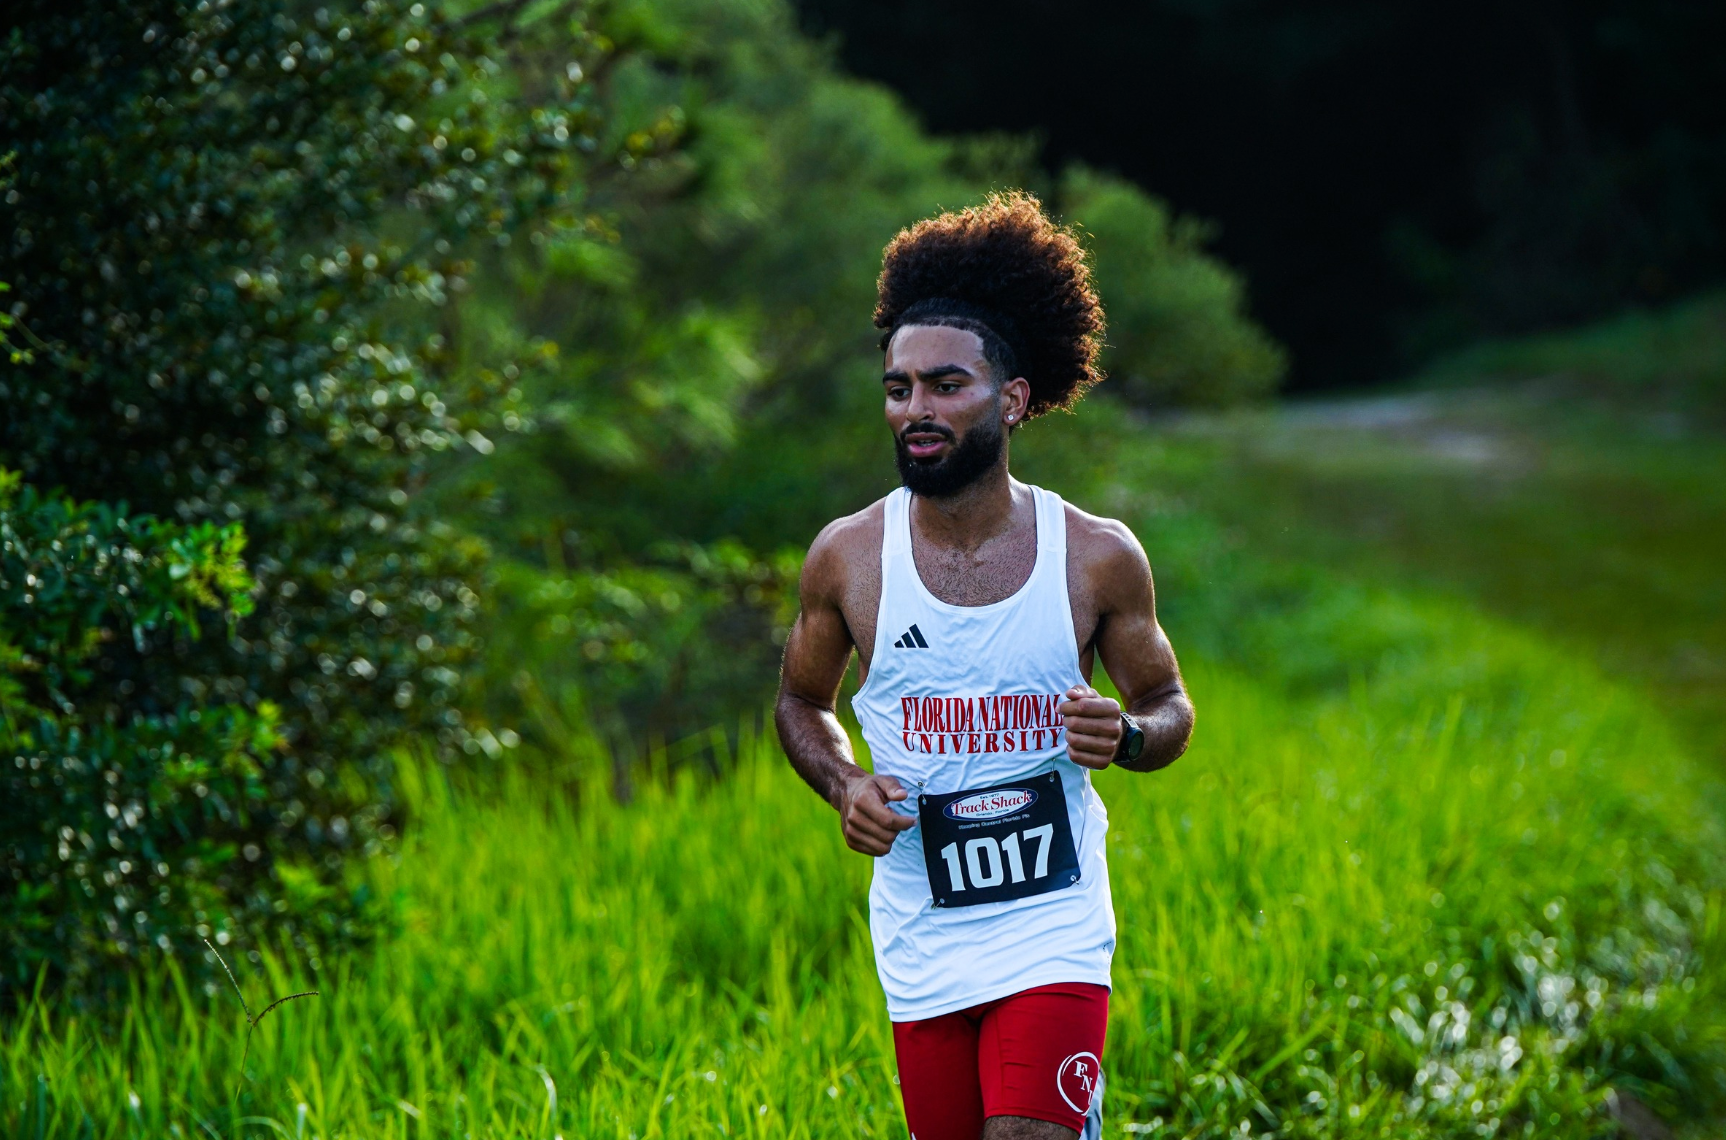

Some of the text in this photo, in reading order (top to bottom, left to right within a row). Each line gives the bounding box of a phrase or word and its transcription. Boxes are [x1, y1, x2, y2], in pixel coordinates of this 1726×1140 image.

[901, 693, 1064, 733] FLORIDA NATIONAL
[902, 728, 1063, 755] UNIVERSITY
[951, 790, 1033, 816] Track Shack
[940, 823, 1054, 892] 1017
